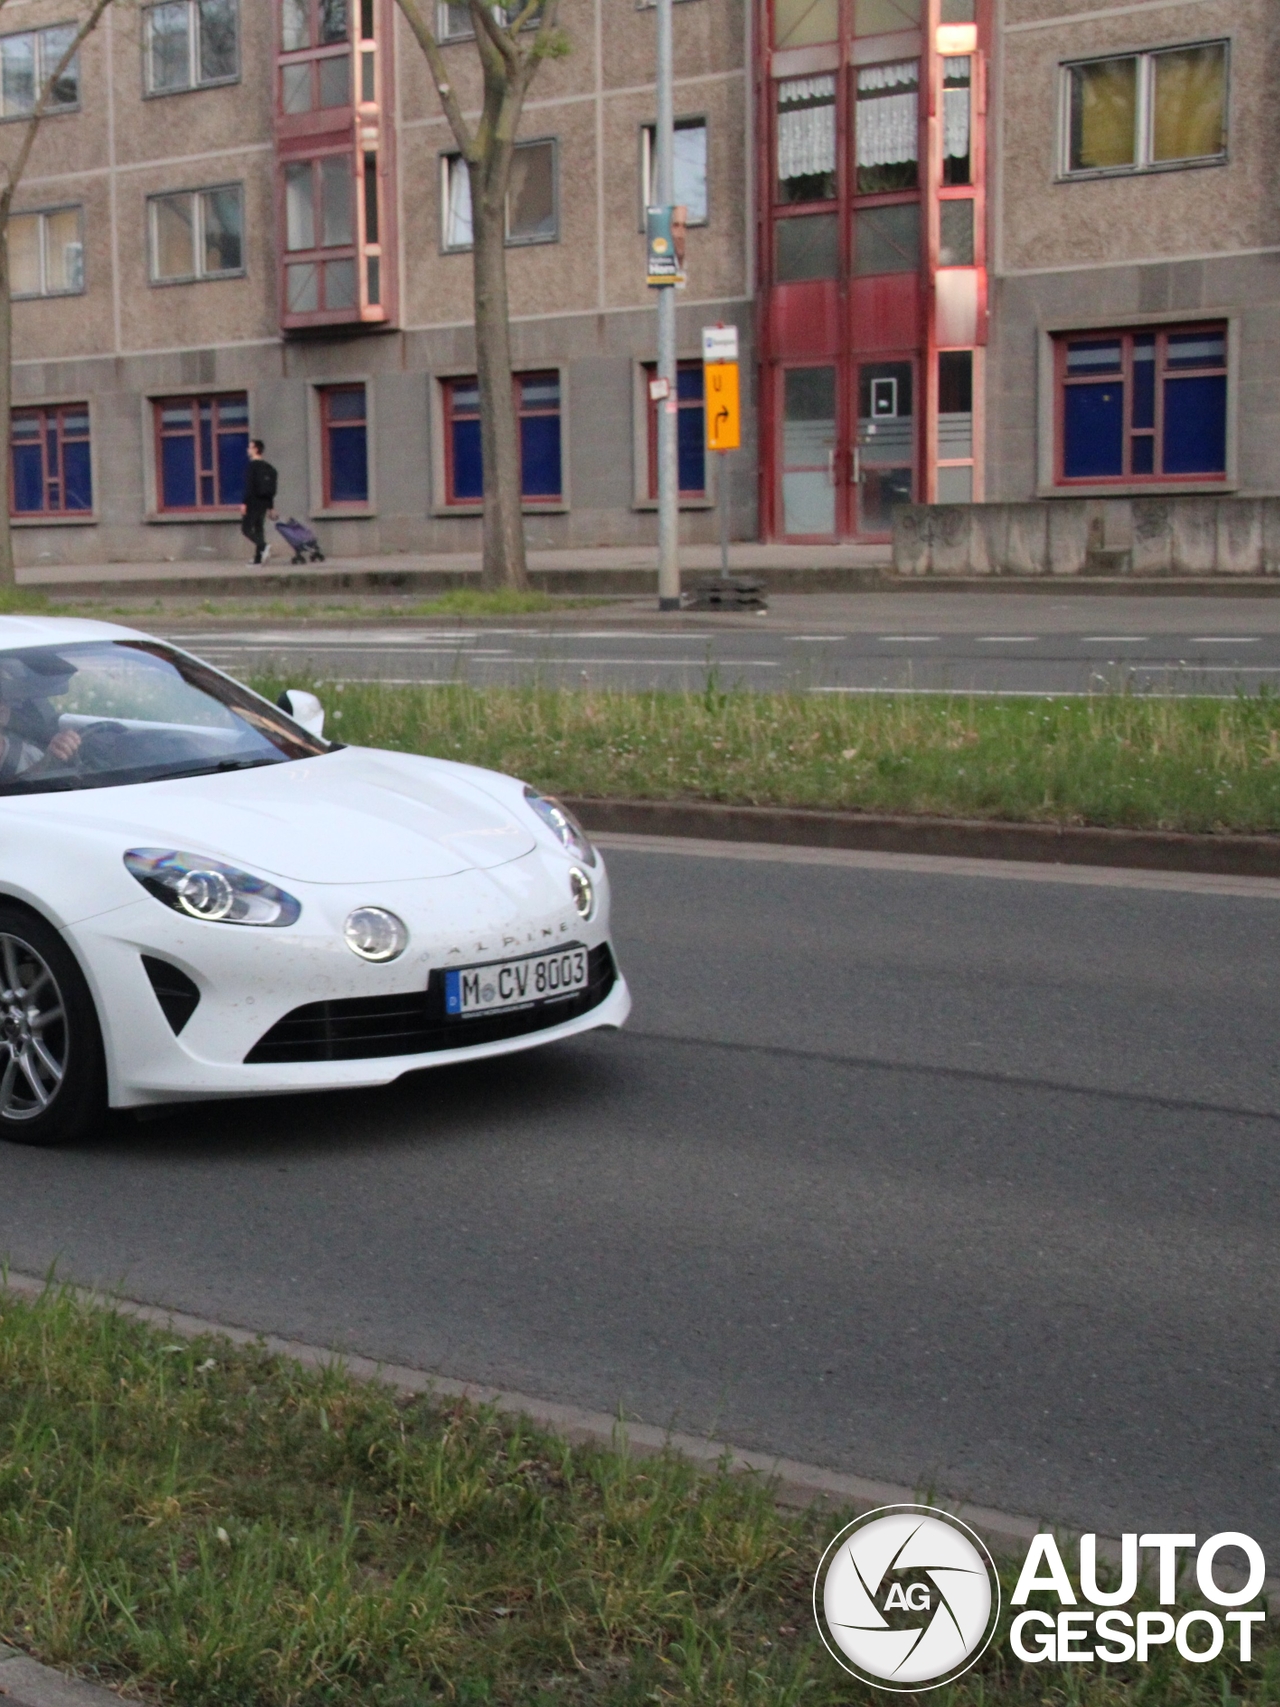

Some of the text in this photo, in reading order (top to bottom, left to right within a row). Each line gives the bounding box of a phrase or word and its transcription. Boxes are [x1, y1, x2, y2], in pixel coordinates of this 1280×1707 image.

[447, 921, 569, 955] ALPINE
[462, 953, 584, 1006] M CV 8003
